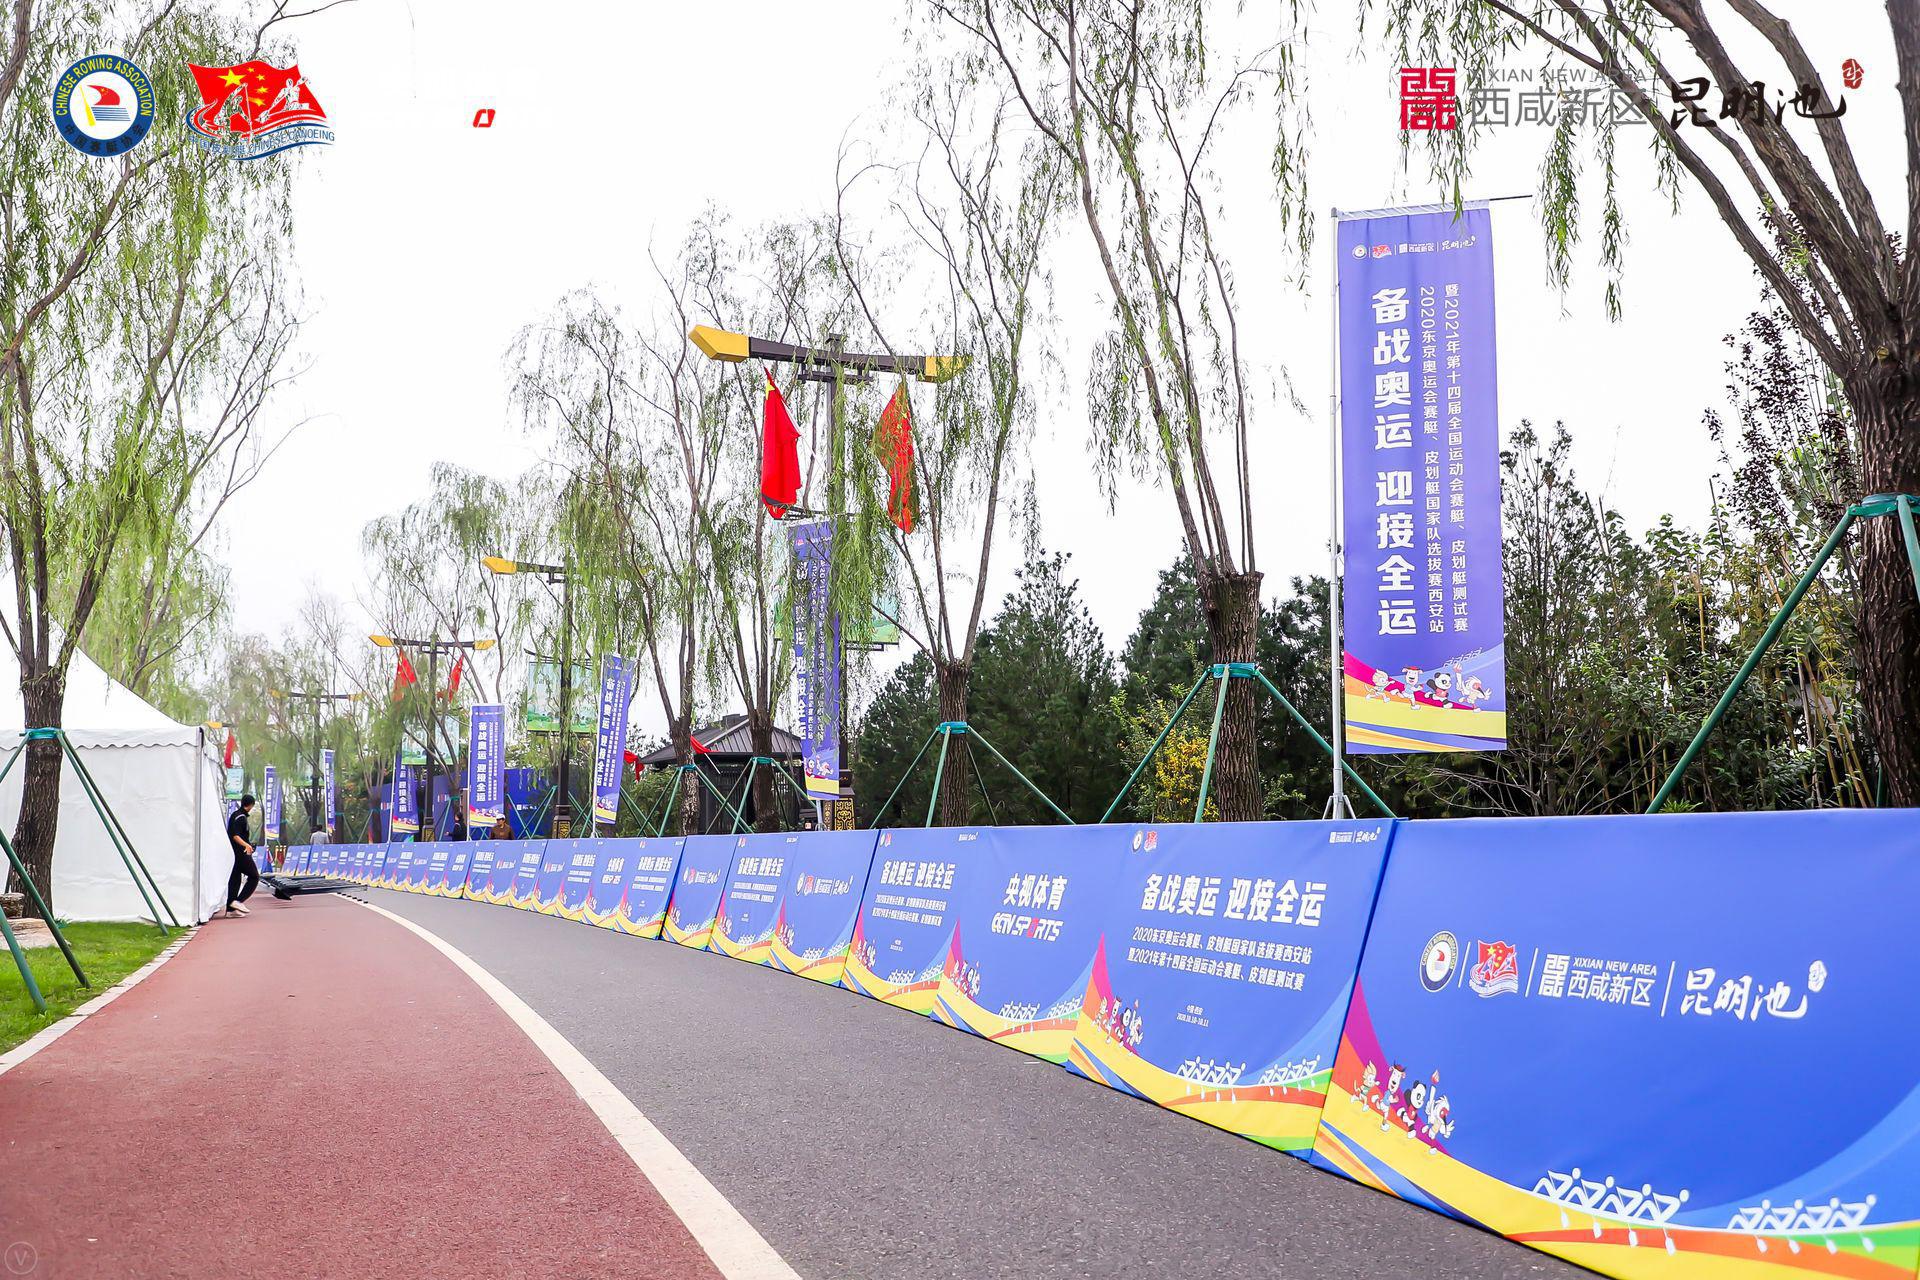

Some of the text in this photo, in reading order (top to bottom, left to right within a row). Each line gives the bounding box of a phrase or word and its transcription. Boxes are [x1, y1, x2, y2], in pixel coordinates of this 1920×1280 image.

[1371, 287, 1417, 636] 备战奥运 迎接全运
[1003, 872, 1068, 911] 央视体育
[1141, 873, 1328, 927] 备战奥运 迎接全运
[1567, 969, 1656, 1007] 西咸新区
[1573, 957, 1657, 976] XIXIAN NEW AREA
[1680, 967, 1808, 1021] 昆明池
